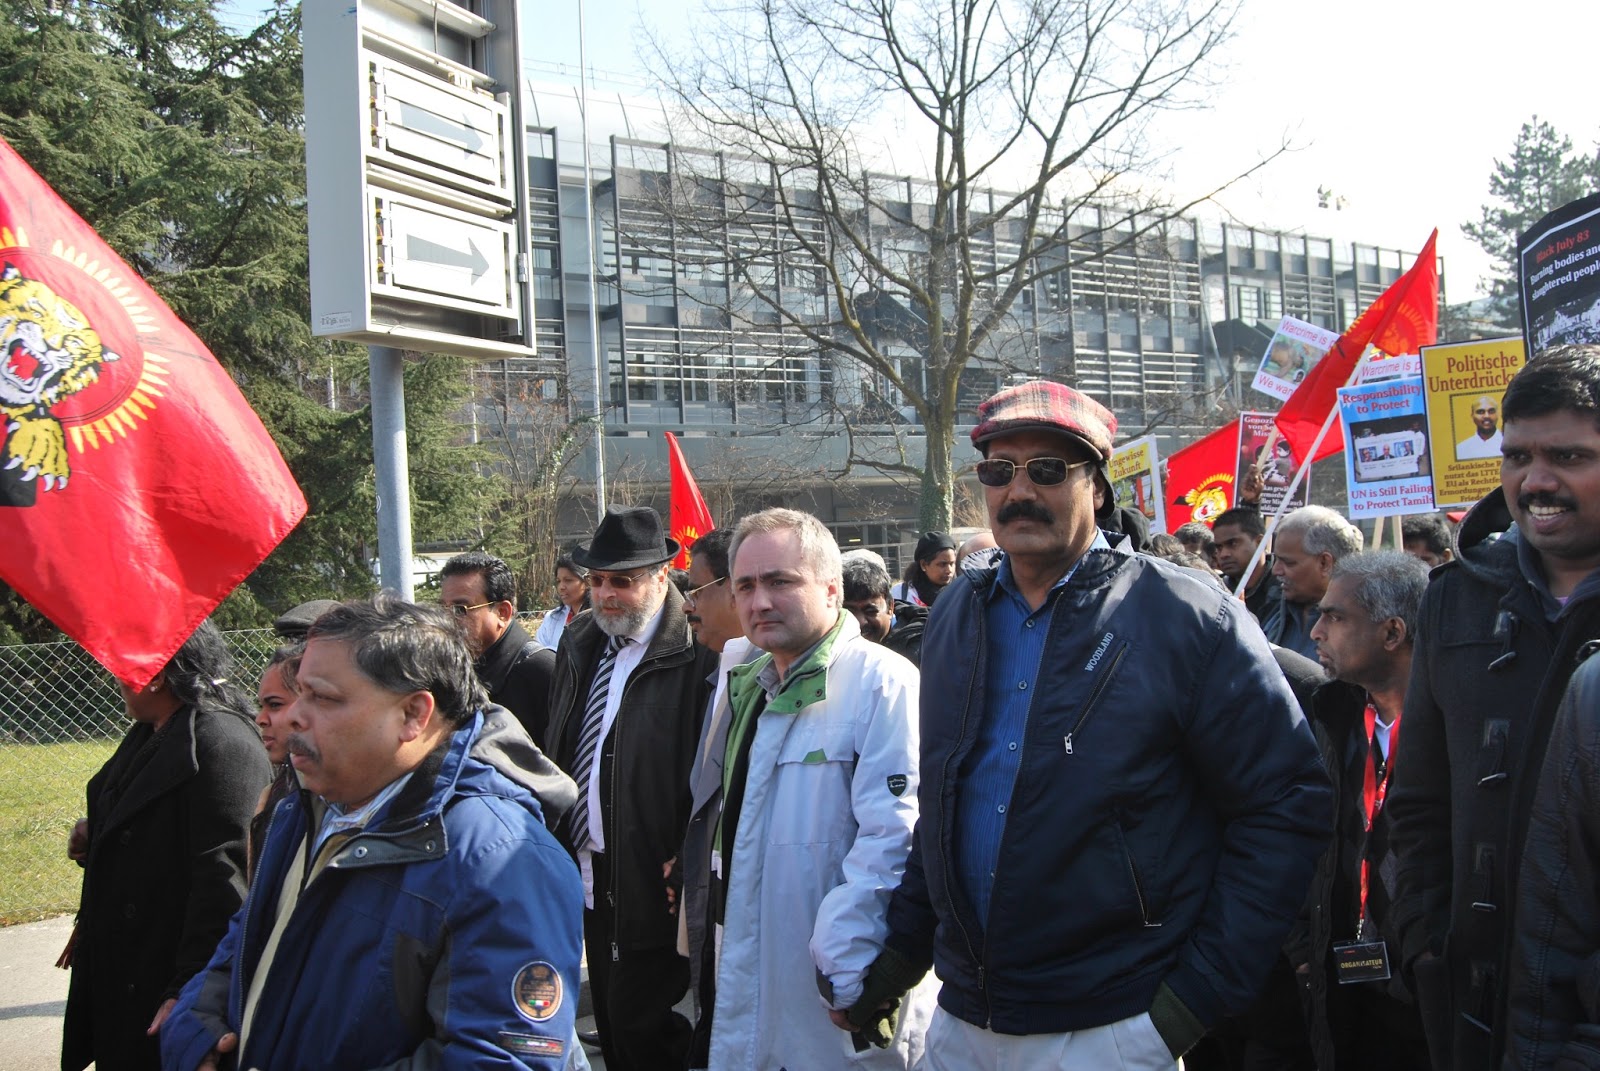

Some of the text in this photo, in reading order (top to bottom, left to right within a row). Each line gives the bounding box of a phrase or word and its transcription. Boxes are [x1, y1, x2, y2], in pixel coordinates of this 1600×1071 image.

[1556, 237, 1575, 253] July
[1577, 229, 1590, 243] 83
[1530, 264, 1554, 286] Burning
[1554, 251, 1585, 270] bodies
[1282, 320, 1319, 342] Warcrime
[1319, 335, 1328, 345] is
[1362, 362, 1400, 377] Warcrime
[1403, 359, 1412, 371] is
[1447, 351, 1518, 374] Politische
[1259, 374, 1294, 396] We wan
[1343, 384, 1421, 404] Responsibility
[1357, 399, 1410, 414] to Protect
[1244, 416, 1275, 425] Genozi
[1108, 449, 1144, 468] Ungewisse
[1113, 461, 1141, 479] Zukunft
[1351, 484, 1433, 499] UN is Still Failing
[1439, 486, 1492, 497] Ermordungen
[1446, 480, 1457, 488] EU
[1458, 479, 1469, 487] als
[1354, 495, 1433, 511] to Protect Tamils
[1084, 632, 1114, 672] WOODLAND
[1340, 958, 1383, 969] ORGANISATEUR
